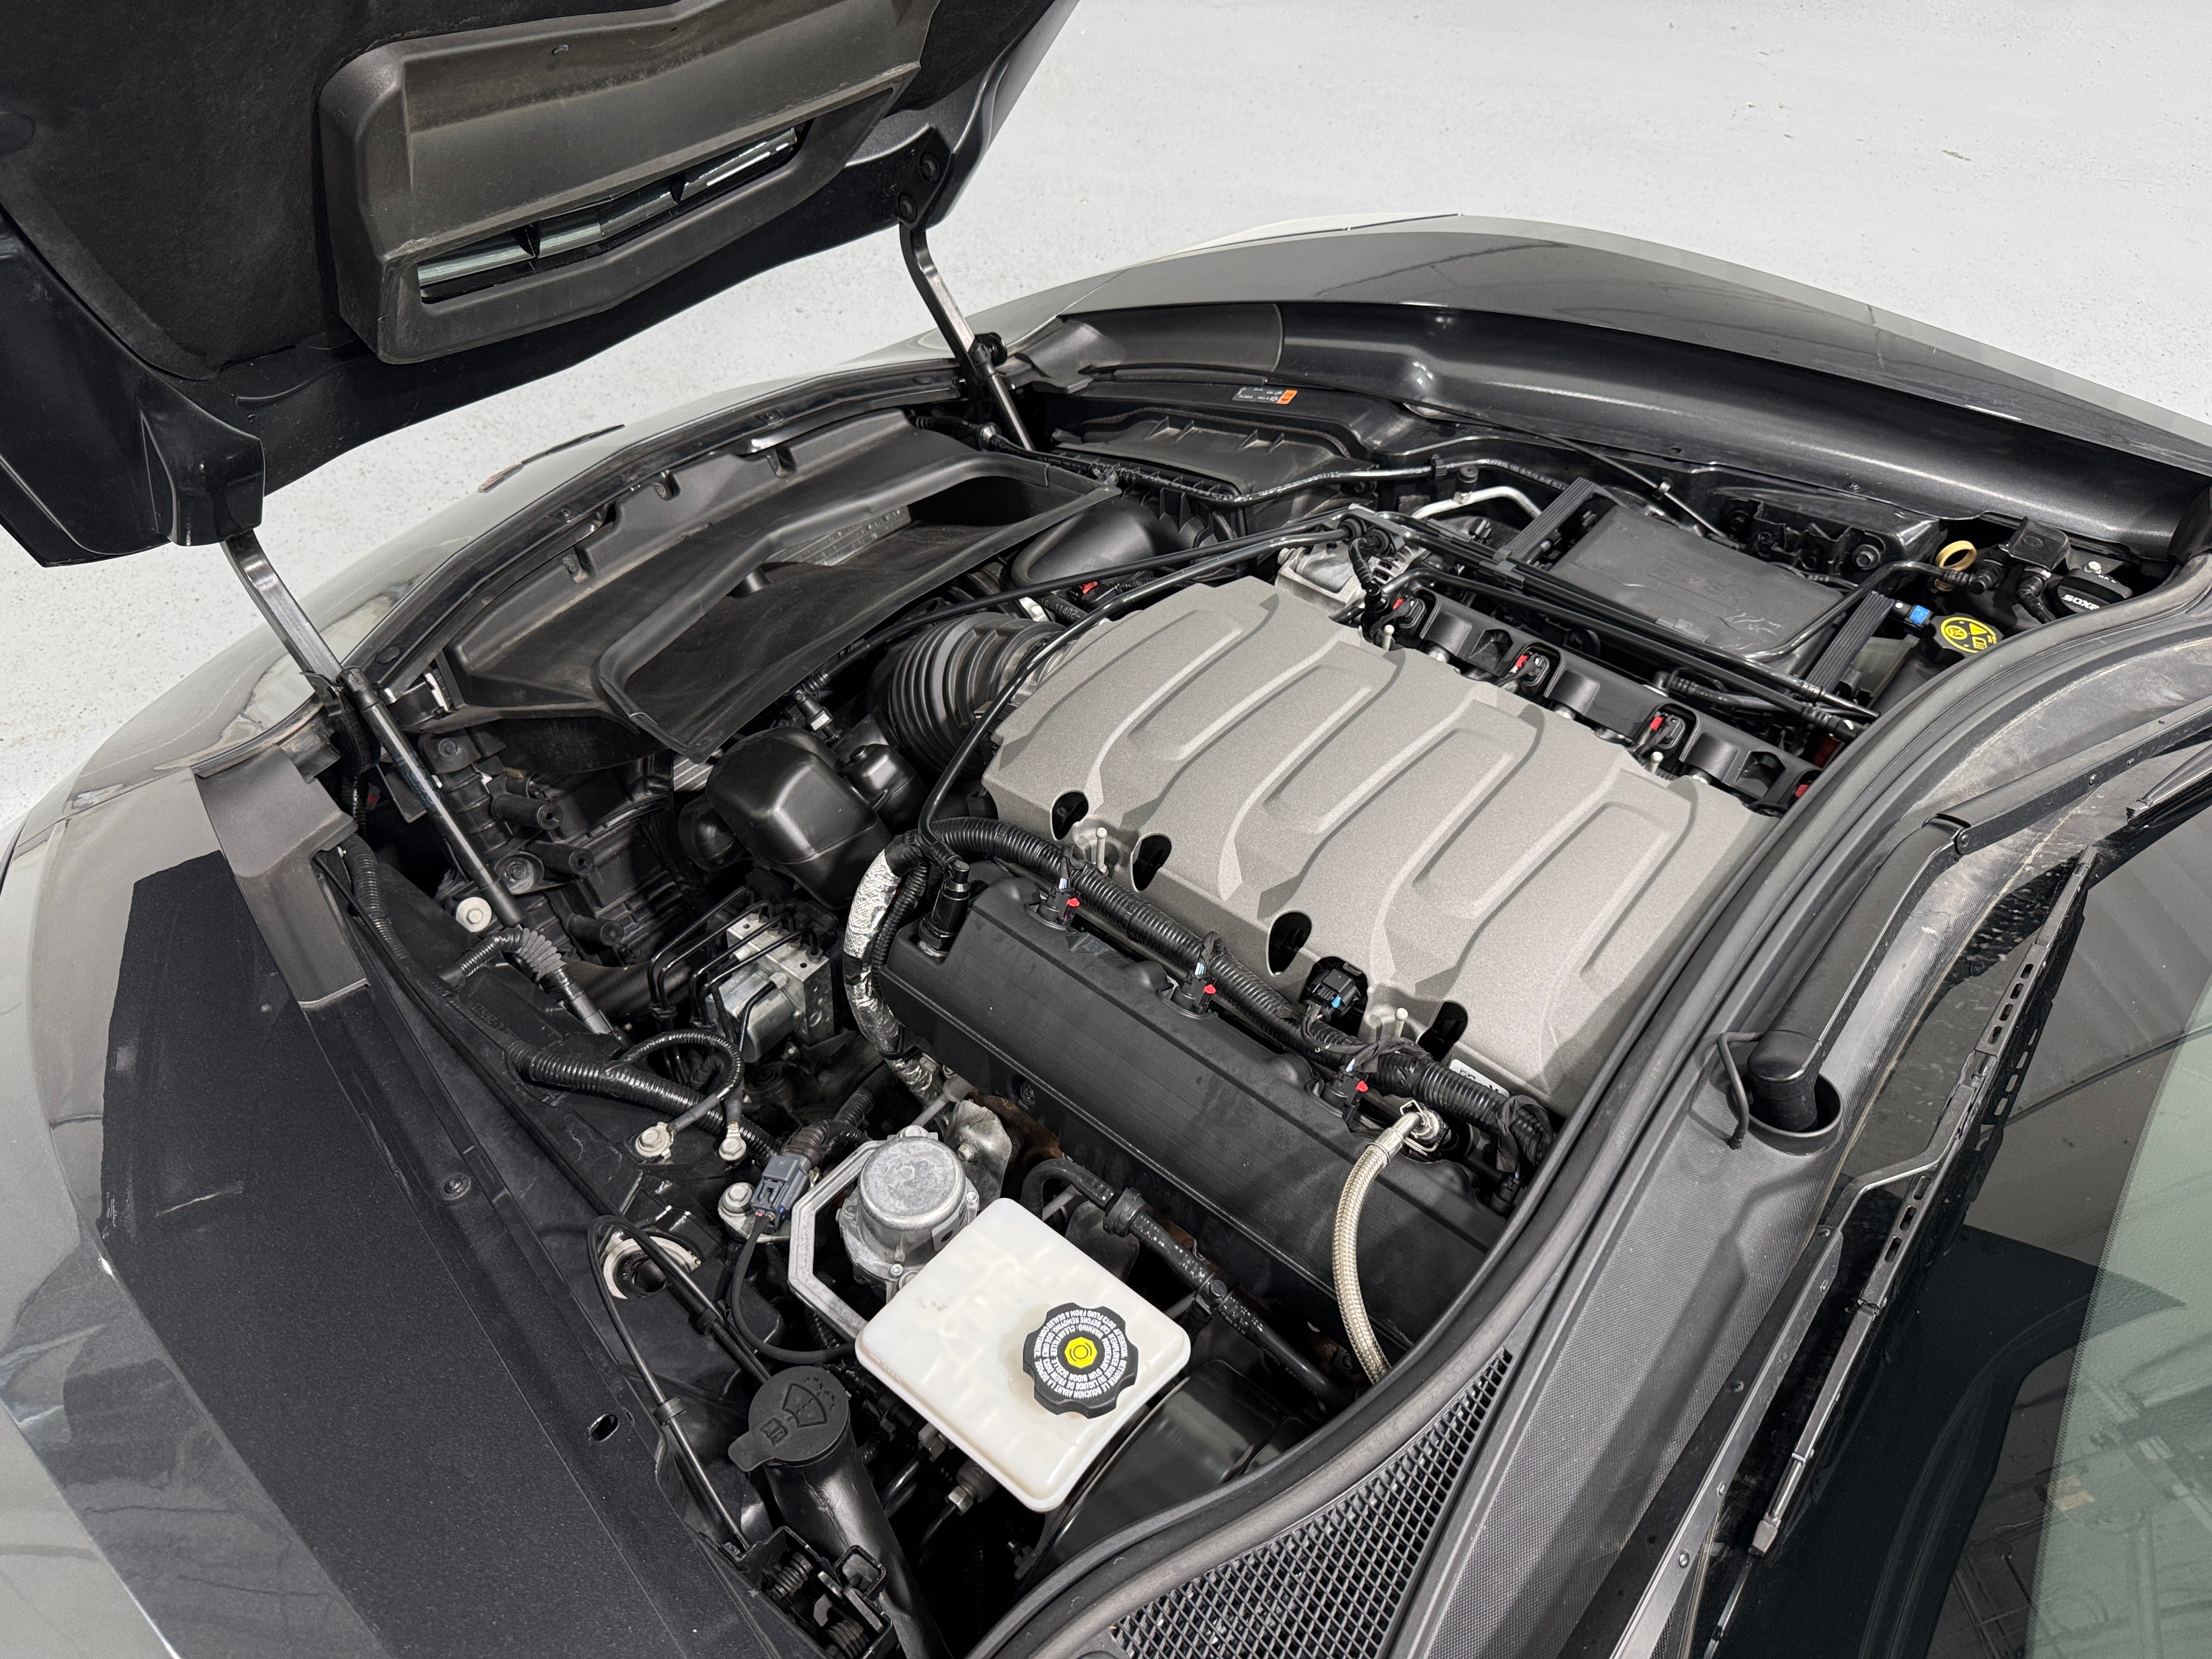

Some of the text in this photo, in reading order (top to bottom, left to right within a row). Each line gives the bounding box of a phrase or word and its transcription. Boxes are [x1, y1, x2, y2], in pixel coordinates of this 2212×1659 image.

[1046, 1313, 1065, 1328] SEALED
[1087, 1310, 1103, 1320] FLUID
[1080, 1316, 1101, 1328] BEFORE
[1102, 1316, 1116, 1329] DOT3
[1058, 1325, 1075, 1339] CLEAN
[1099, 1324, 1110, 1334] CAP
[1045, 1332, 1054, 1343] USE
[1050, 1336, 1061, 1356] FILLER
[1100, 1338, 1111, 1370] PROVENANT
[1043, 1358, 1054, 1373] DOT3
[1104, 1365, 1115, 1378] QUE
[1050, 1371, 1066, 1386] FREIN
[1068, 1373, 1087, 1382] BIDON
[1108, 1359, 1126, 1386] NETTOYER
[1054, 1385, 1073, 1397] AVANT
[1075, 1379, 1098, 1390] LIQUIDE
[1074, 1387, 1102, 1398] BOUCHON
